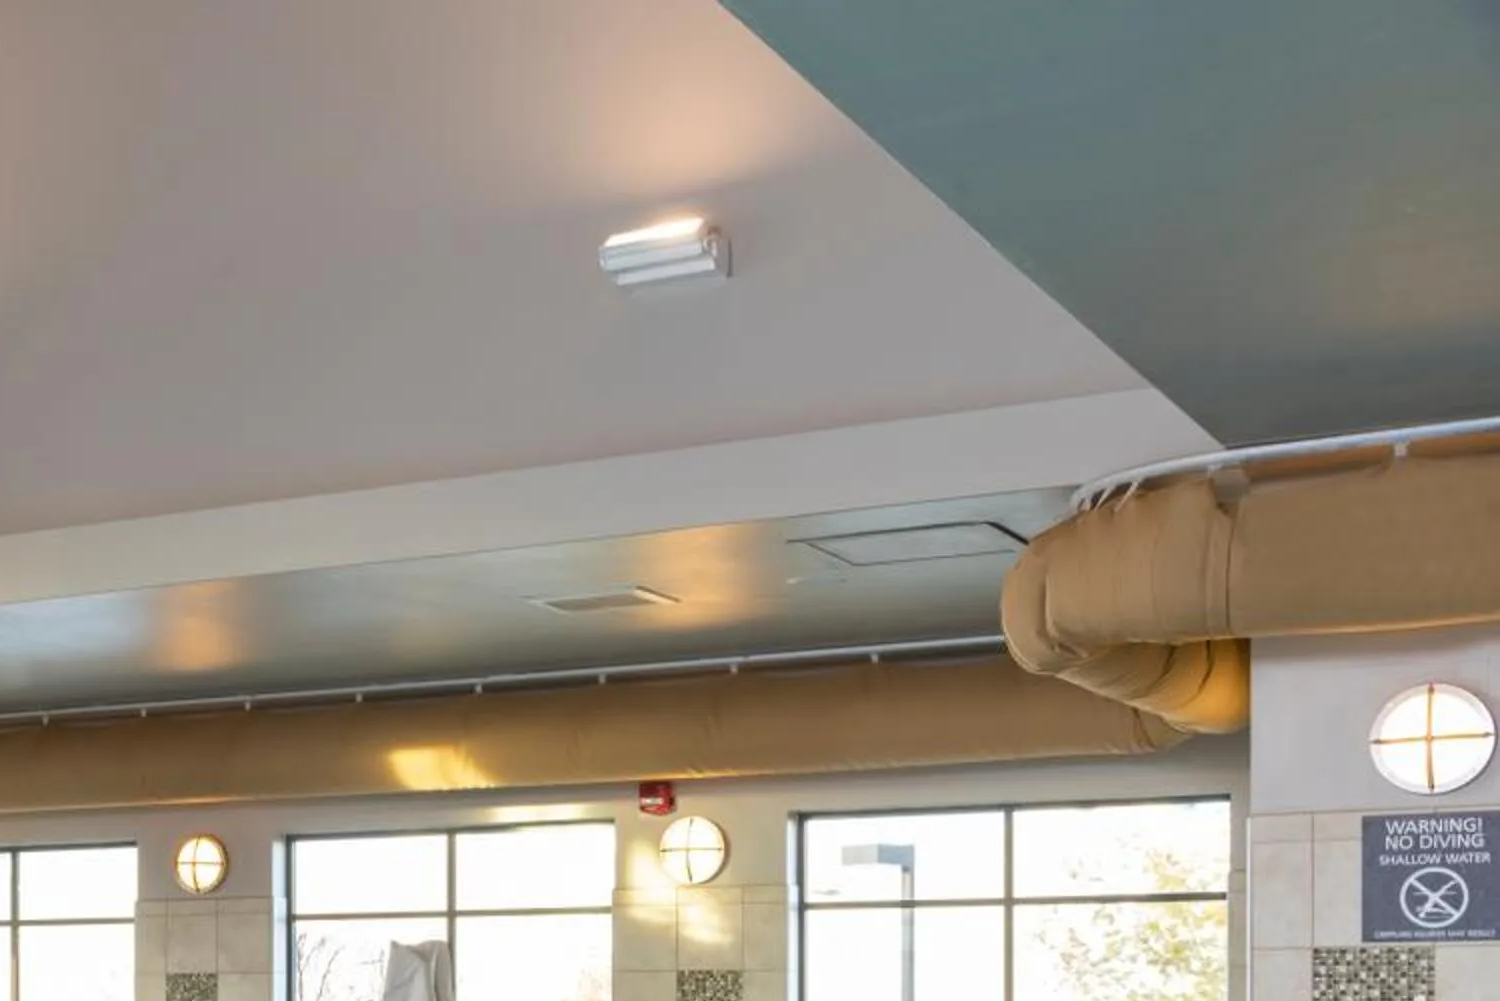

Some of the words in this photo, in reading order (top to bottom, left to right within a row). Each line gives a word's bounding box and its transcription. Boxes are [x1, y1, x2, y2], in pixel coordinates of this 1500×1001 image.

[1385, 817, 1482, 835] WARNING!
[1385, 835, 1413, 851] NO
[1420, 833, 1485, 848] DIVING
[1380, 853, 1441, 865] SHALLOW
[1445, 851, 1491, 864] WATER
